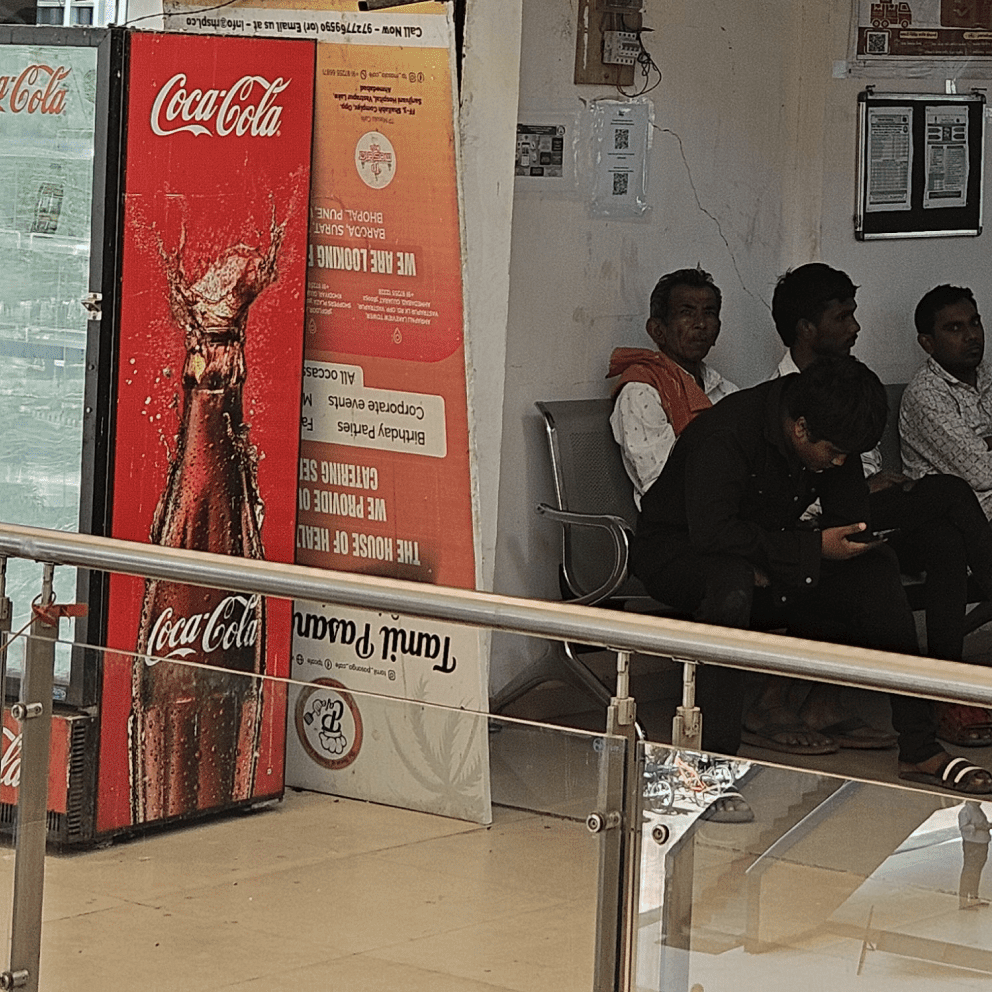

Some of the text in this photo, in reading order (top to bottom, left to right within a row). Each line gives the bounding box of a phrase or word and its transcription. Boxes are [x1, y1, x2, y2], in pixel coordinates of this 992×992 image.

[253, 21, 262, 31] at
[264, 22, 274, 30] us
[276, 22, 302, 33] Email
[304, 22, 319, 34] (or)
[321, 21, 372, 34] 9727769590
[382, 26, 402, 37] Now
[404, 26, 422, 38] Call
[150, 73, 292, 137] Coca-Cola
[317, 245, 367, 272] LOOKING
[370, 250, 393, 274] ARE
[397, 252, 416, 276] WE
[340, 371, 356, 385] All
[328, 395, 425, 420] Corporate events
[337, 421, 426, 446] Birthday Parties
[321, 461, 378, 490] CATERING
[313, 489, 364, 518] PROVIDE
[367, 497, 387, 522] WE
[334, 530, 349, 555] OF
[352, 532, 393, 562] HOUSE
[396, 539, 420, 566] THE
[145, 593, 261, 666] Coca-Cola
[379, 626, 457, 674] Tamil
